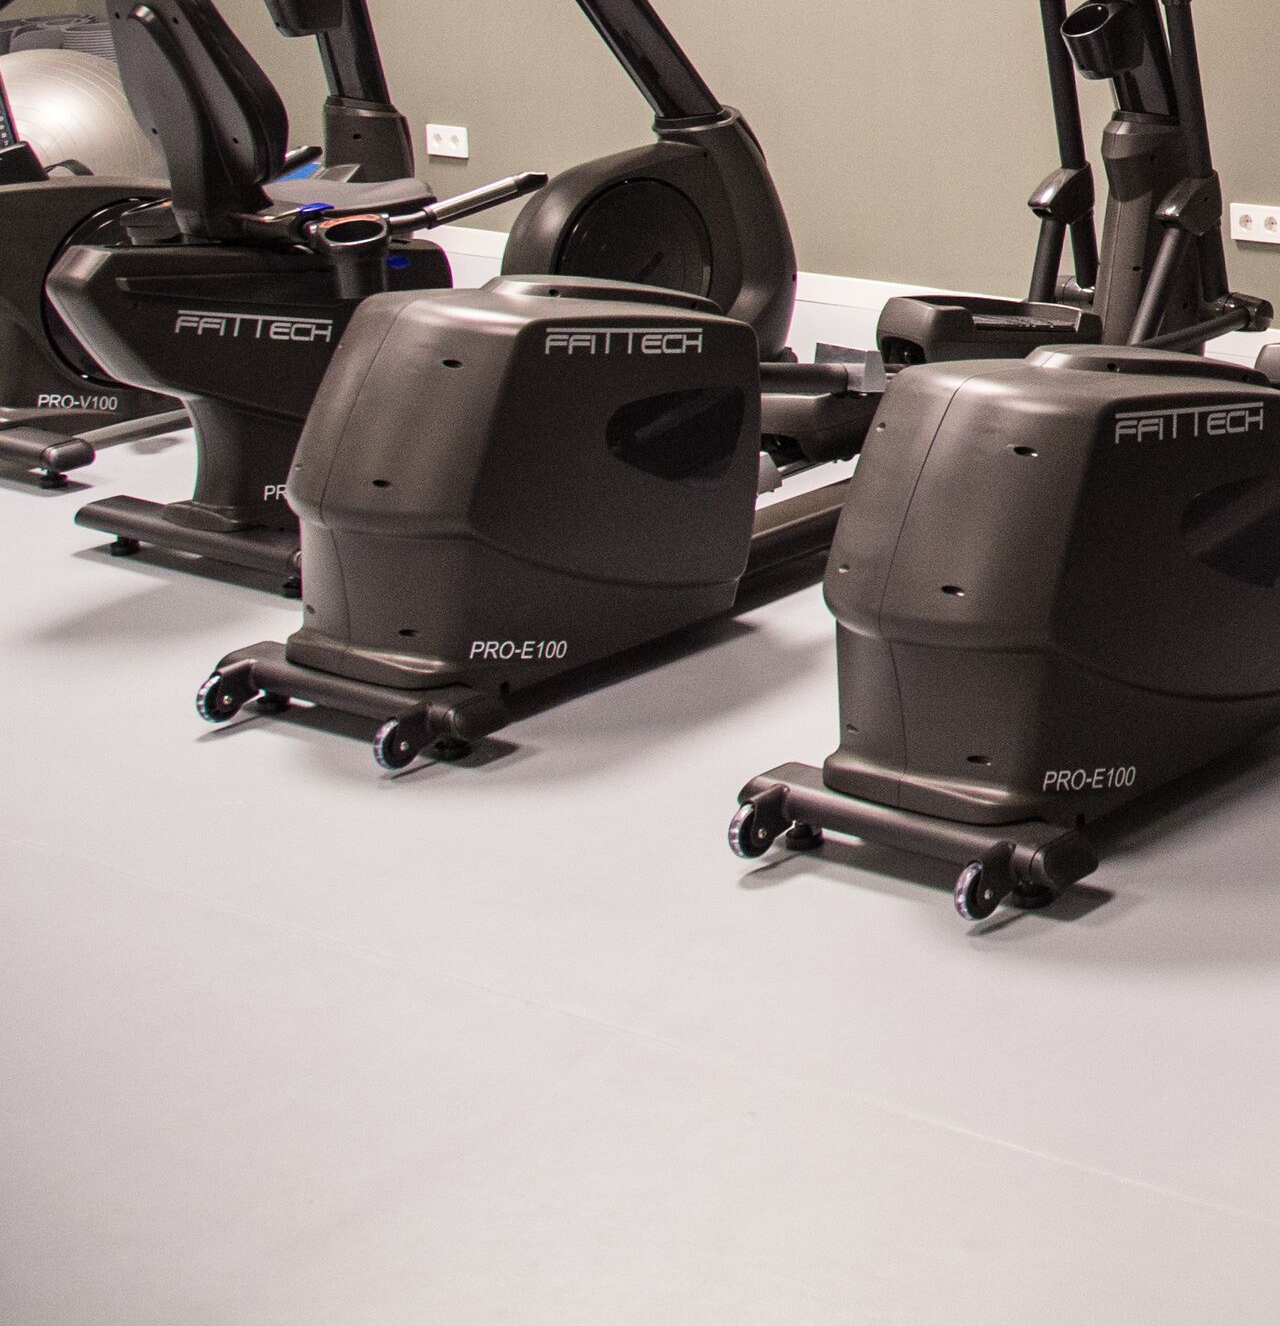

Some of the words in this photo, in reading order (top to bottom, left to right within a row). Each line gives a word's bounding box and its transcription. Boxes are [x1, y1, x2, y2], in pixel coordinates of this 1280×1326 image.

[37, 394, 118, 410] PRO-V100
[469, 640, 568, 659] PRO-E100
[1042, 767, 1137, 792] PRO-E100
